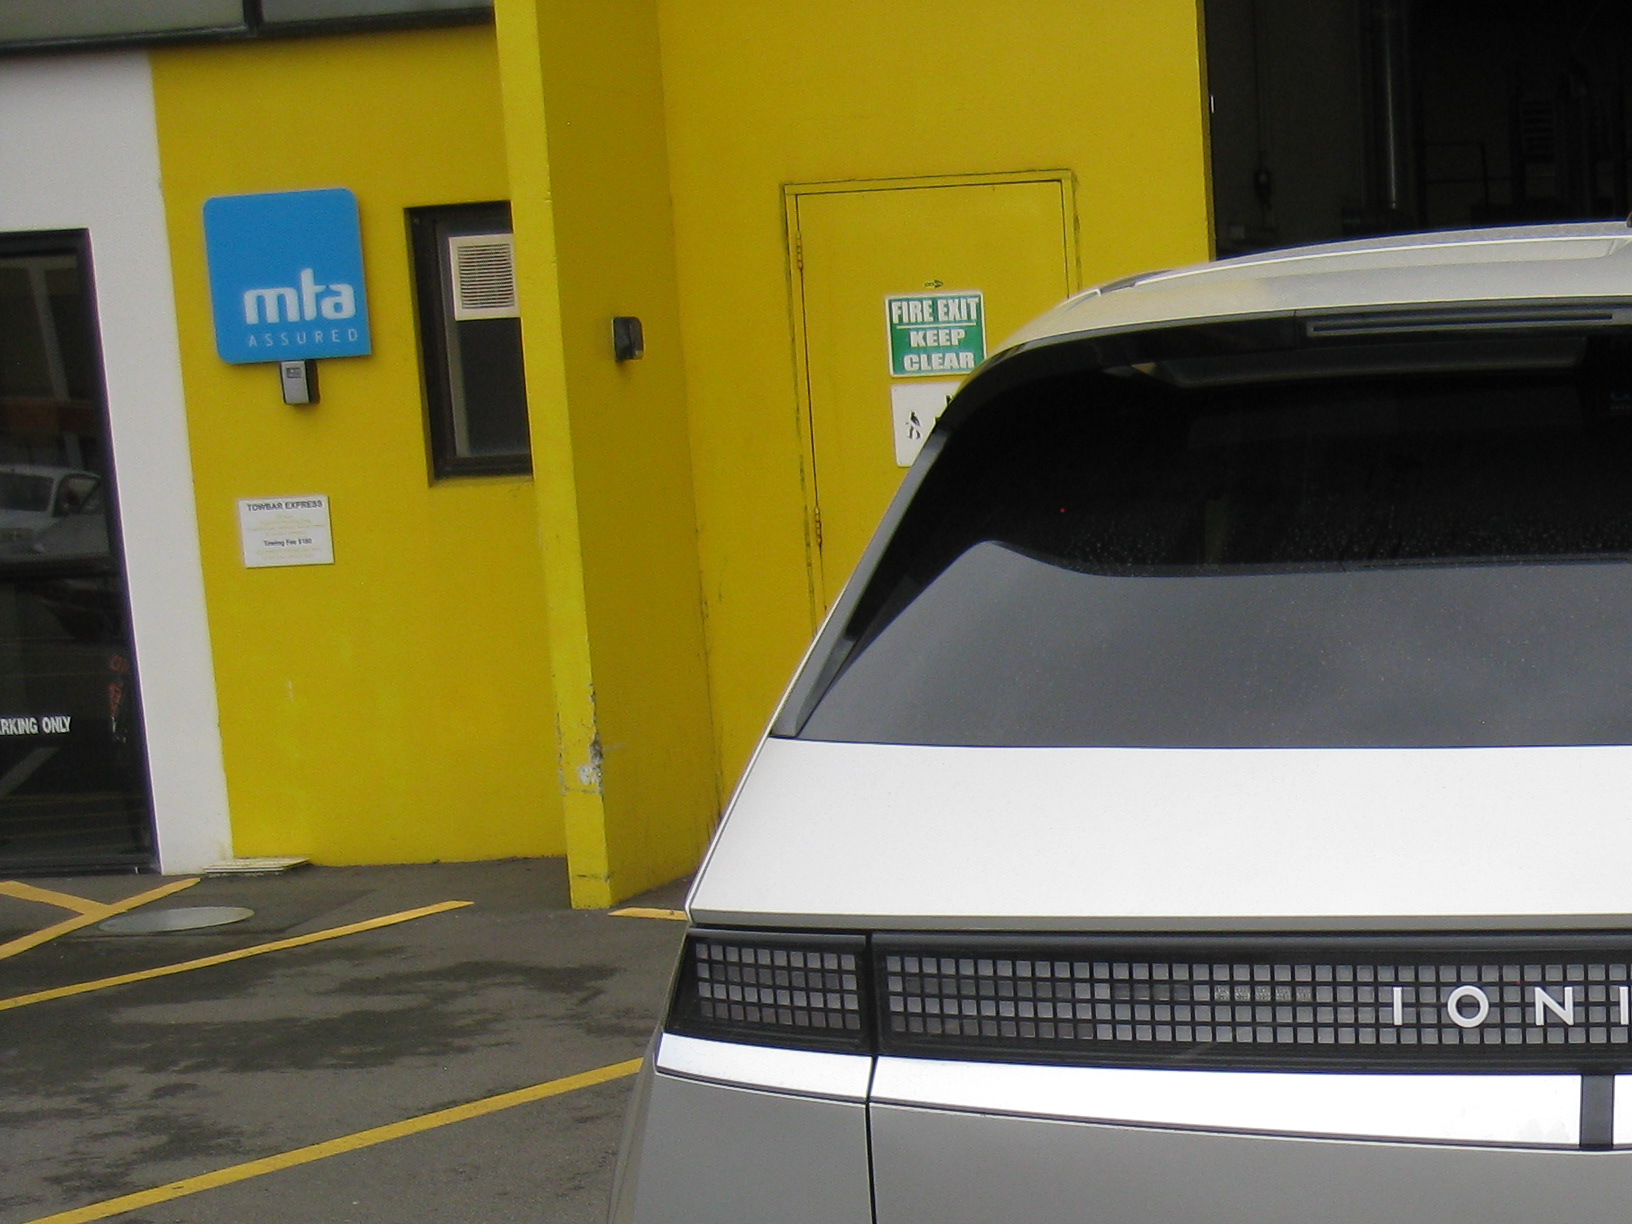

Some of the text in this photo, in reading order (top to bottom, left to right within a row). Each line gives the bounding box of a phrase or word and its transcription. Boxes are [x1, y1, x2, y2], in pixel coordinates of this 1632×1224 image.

[243, 268, 356, 325] mta
[891, 297, 979, 324] FIRE EXIT
[249, 328, 358, 347] ASSURED
[909, 329, 966, 348] KEEP
[903, 351, 975, 371] CLEAR
[247, 499, 323, 512] TOWBAR EXPRESS
[0, 716, 72, 736] RKING ONLY
